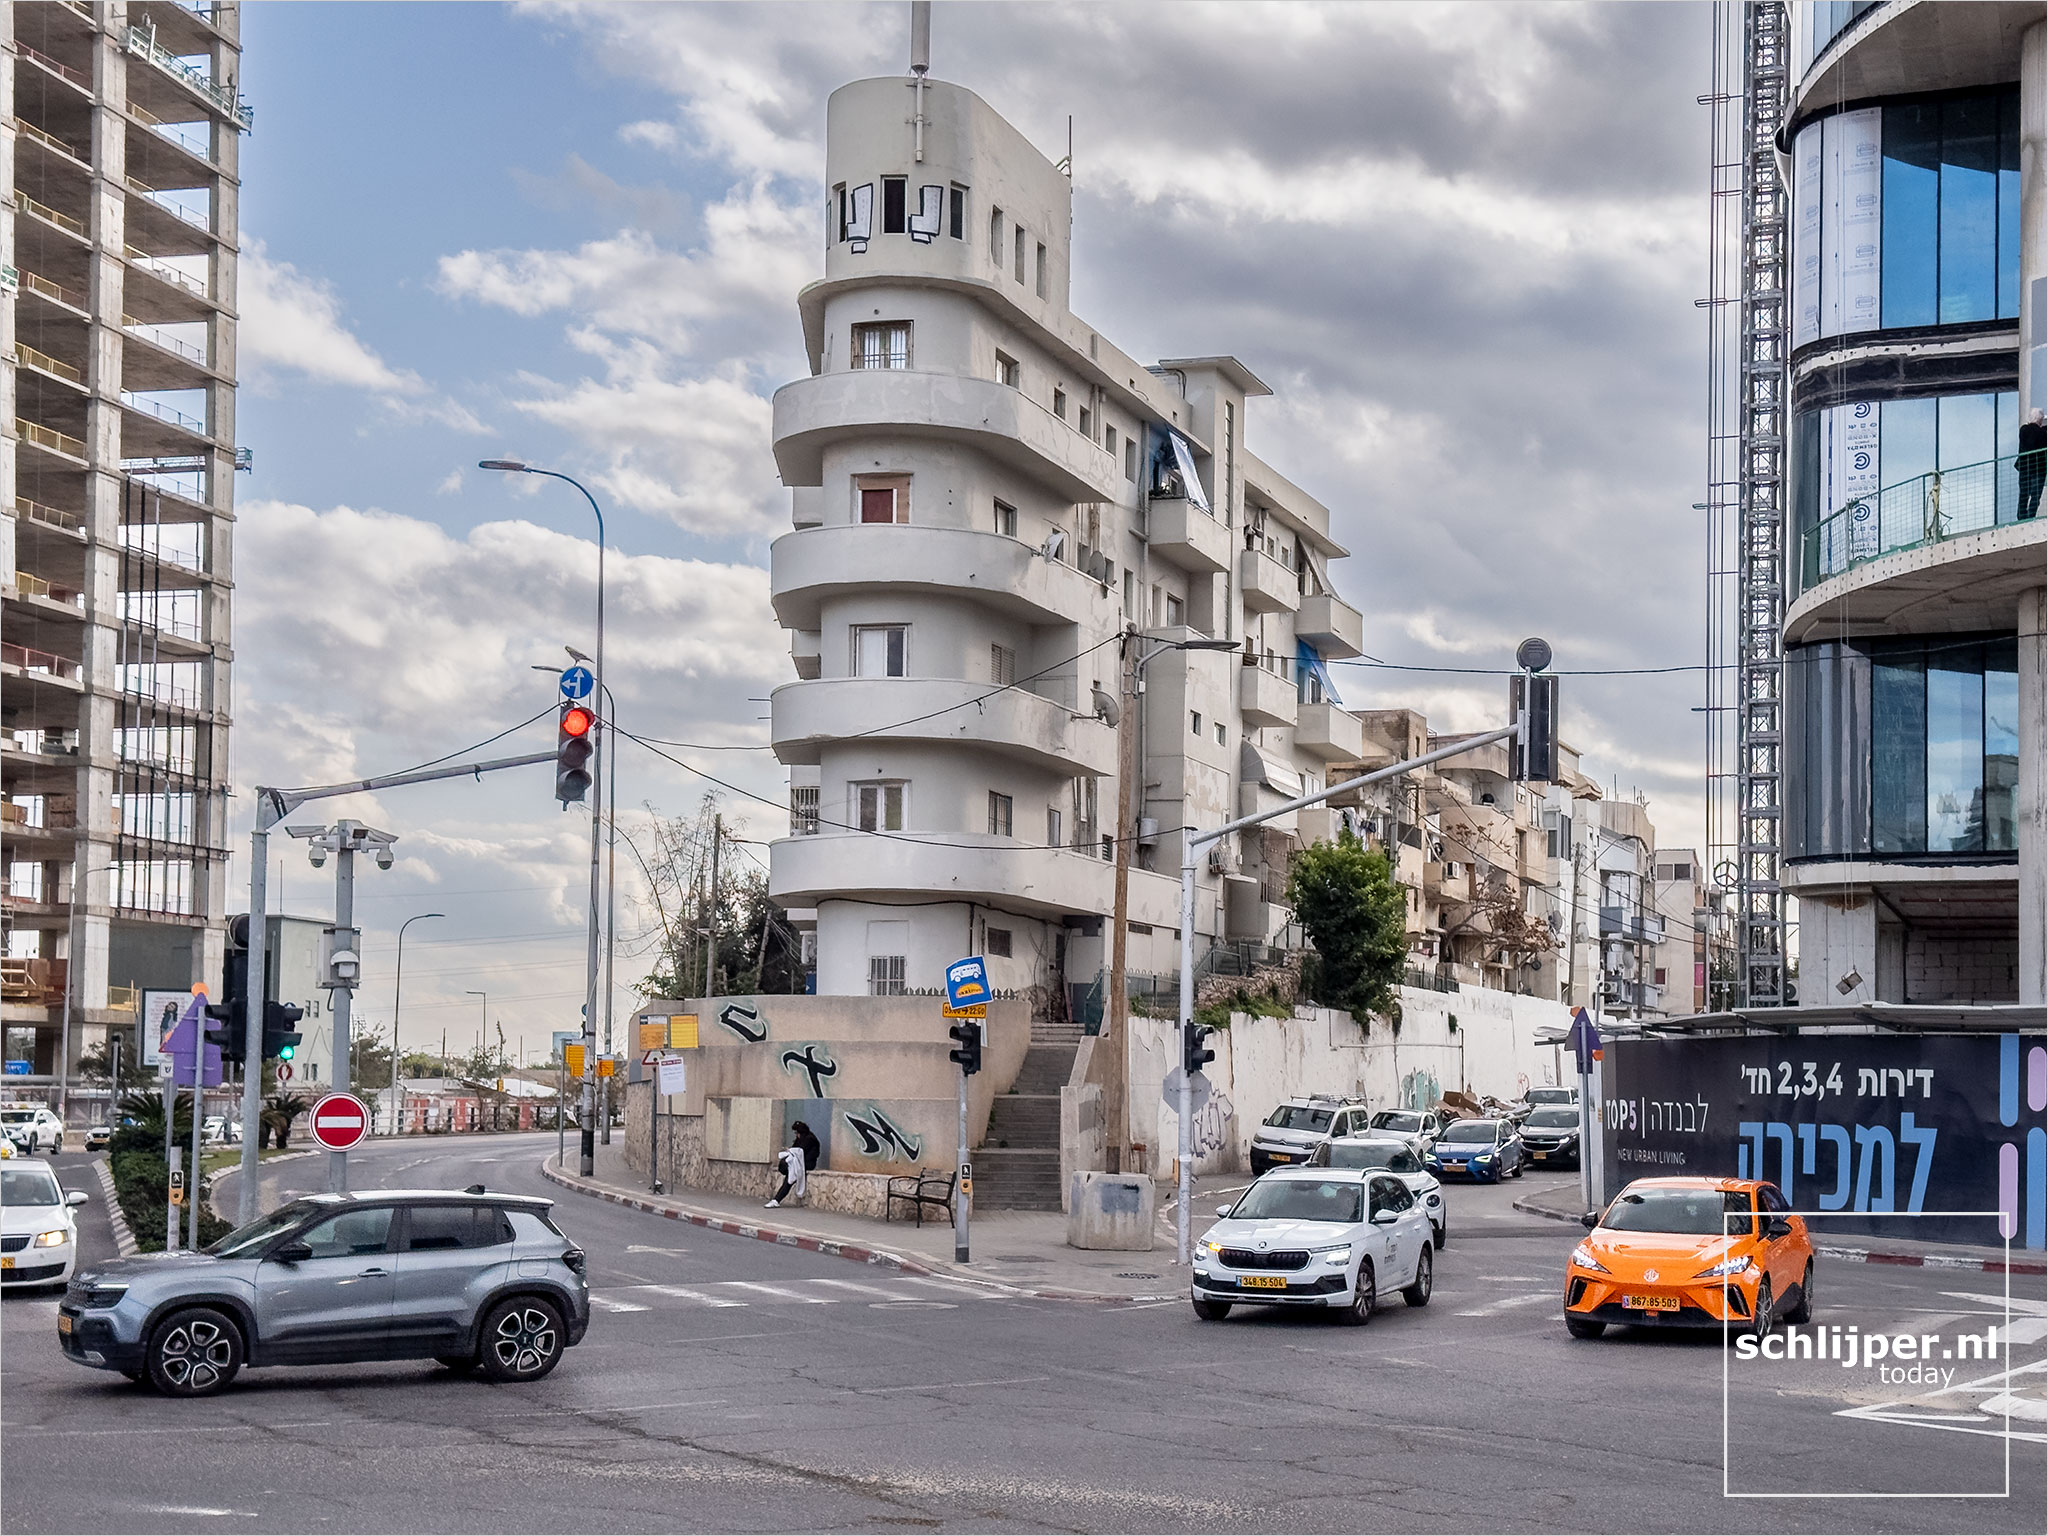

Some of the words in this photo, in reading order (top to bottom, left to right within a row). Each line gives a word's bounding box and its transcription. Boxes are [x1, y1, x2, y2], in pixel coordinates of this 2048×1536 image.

[1777, 1061, 1844, 1101] 2,3,4
[1858, 1068, 1934, 1098] דירות
[1651, 1092, 1709, 1133] לבנדה
[1617, 1148, 1633, 1161] NEW
[1634, 1149, 1658, 1163] URBAN
[1659, 1151, 1686, 1165] LIVING
[1738, 1112, 1938, 1217] למכירה
